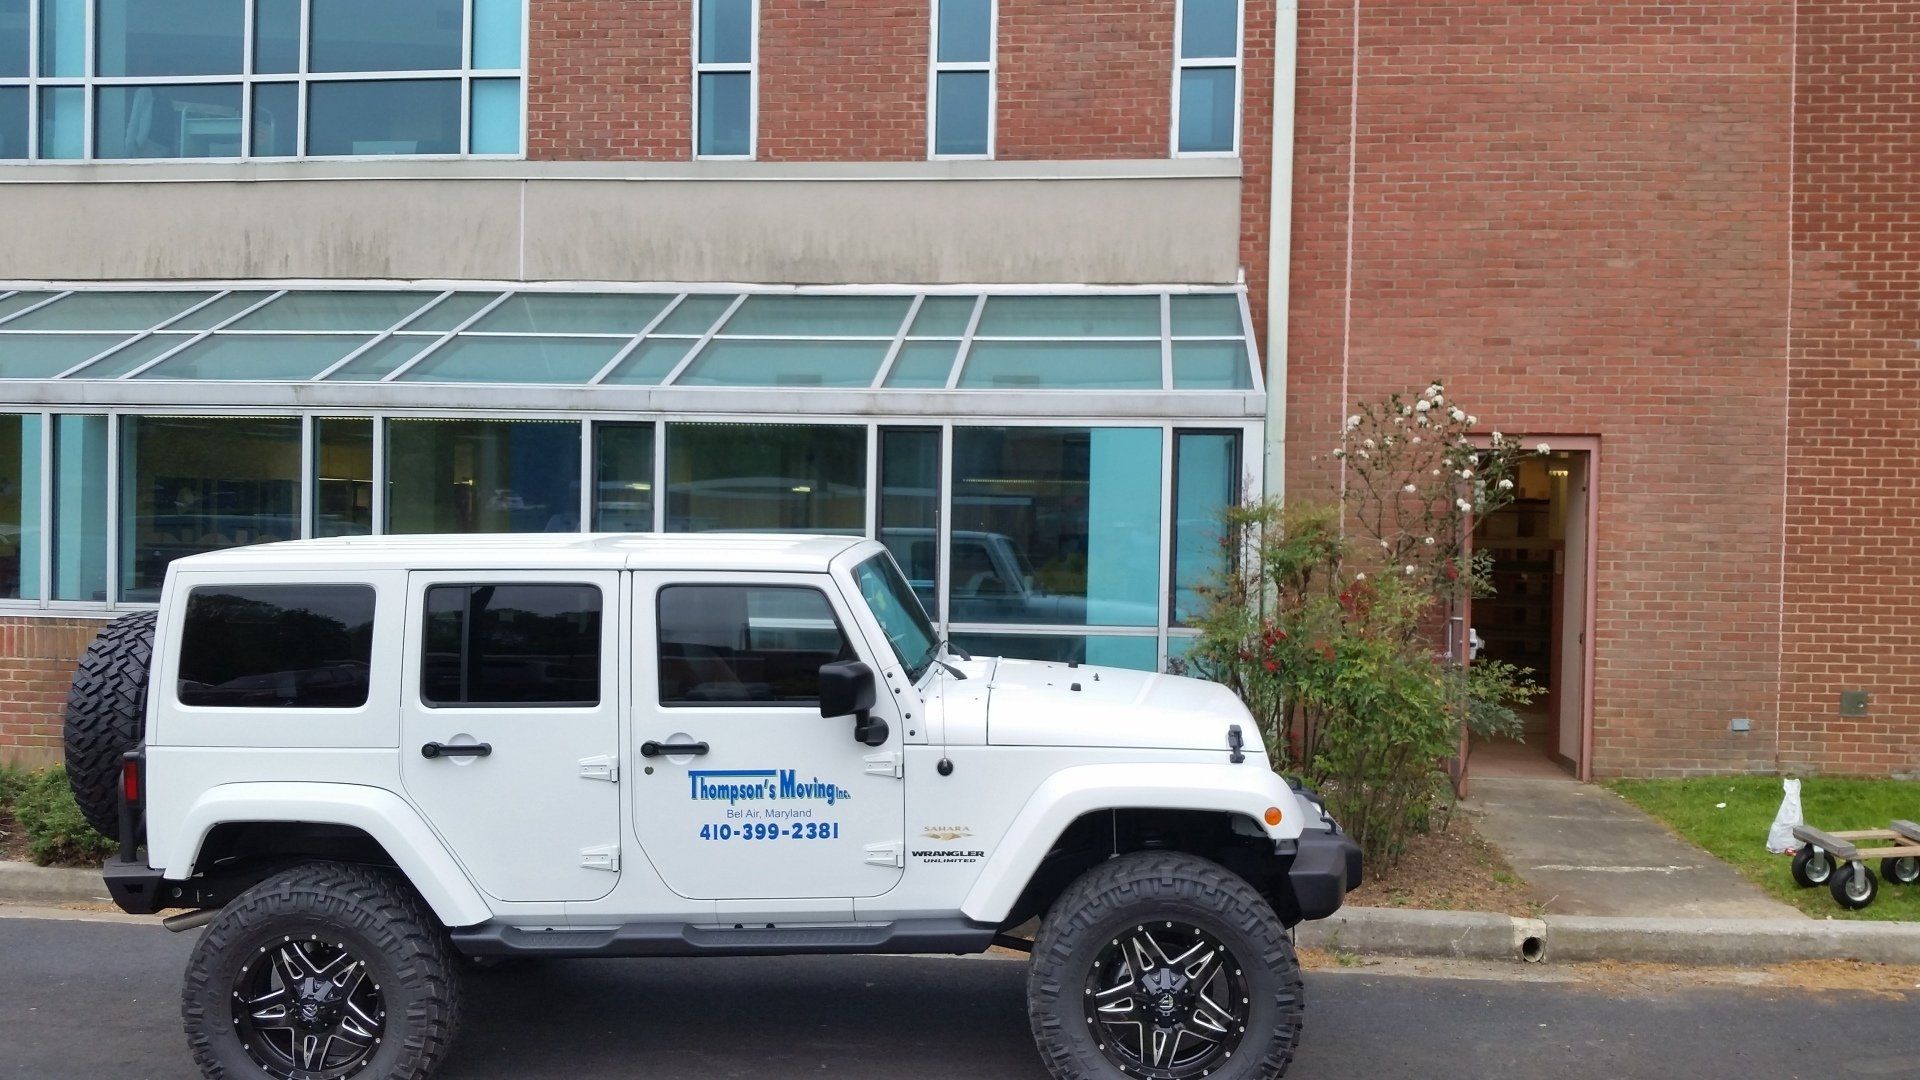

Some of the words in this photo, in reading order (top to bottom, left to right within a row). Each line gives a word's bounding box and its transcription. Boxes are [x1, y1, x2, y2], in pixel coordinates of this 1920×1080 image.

[688, 770, 776, 806] Thompson's
[780, 769, 835, 806] Moving
[727, 809, 743, 818] Bel
[746, 809, 762, 819] Air,
[765, 809, 812, 819] Maryland
[700, 822, 839, 840] 410-399-2381
